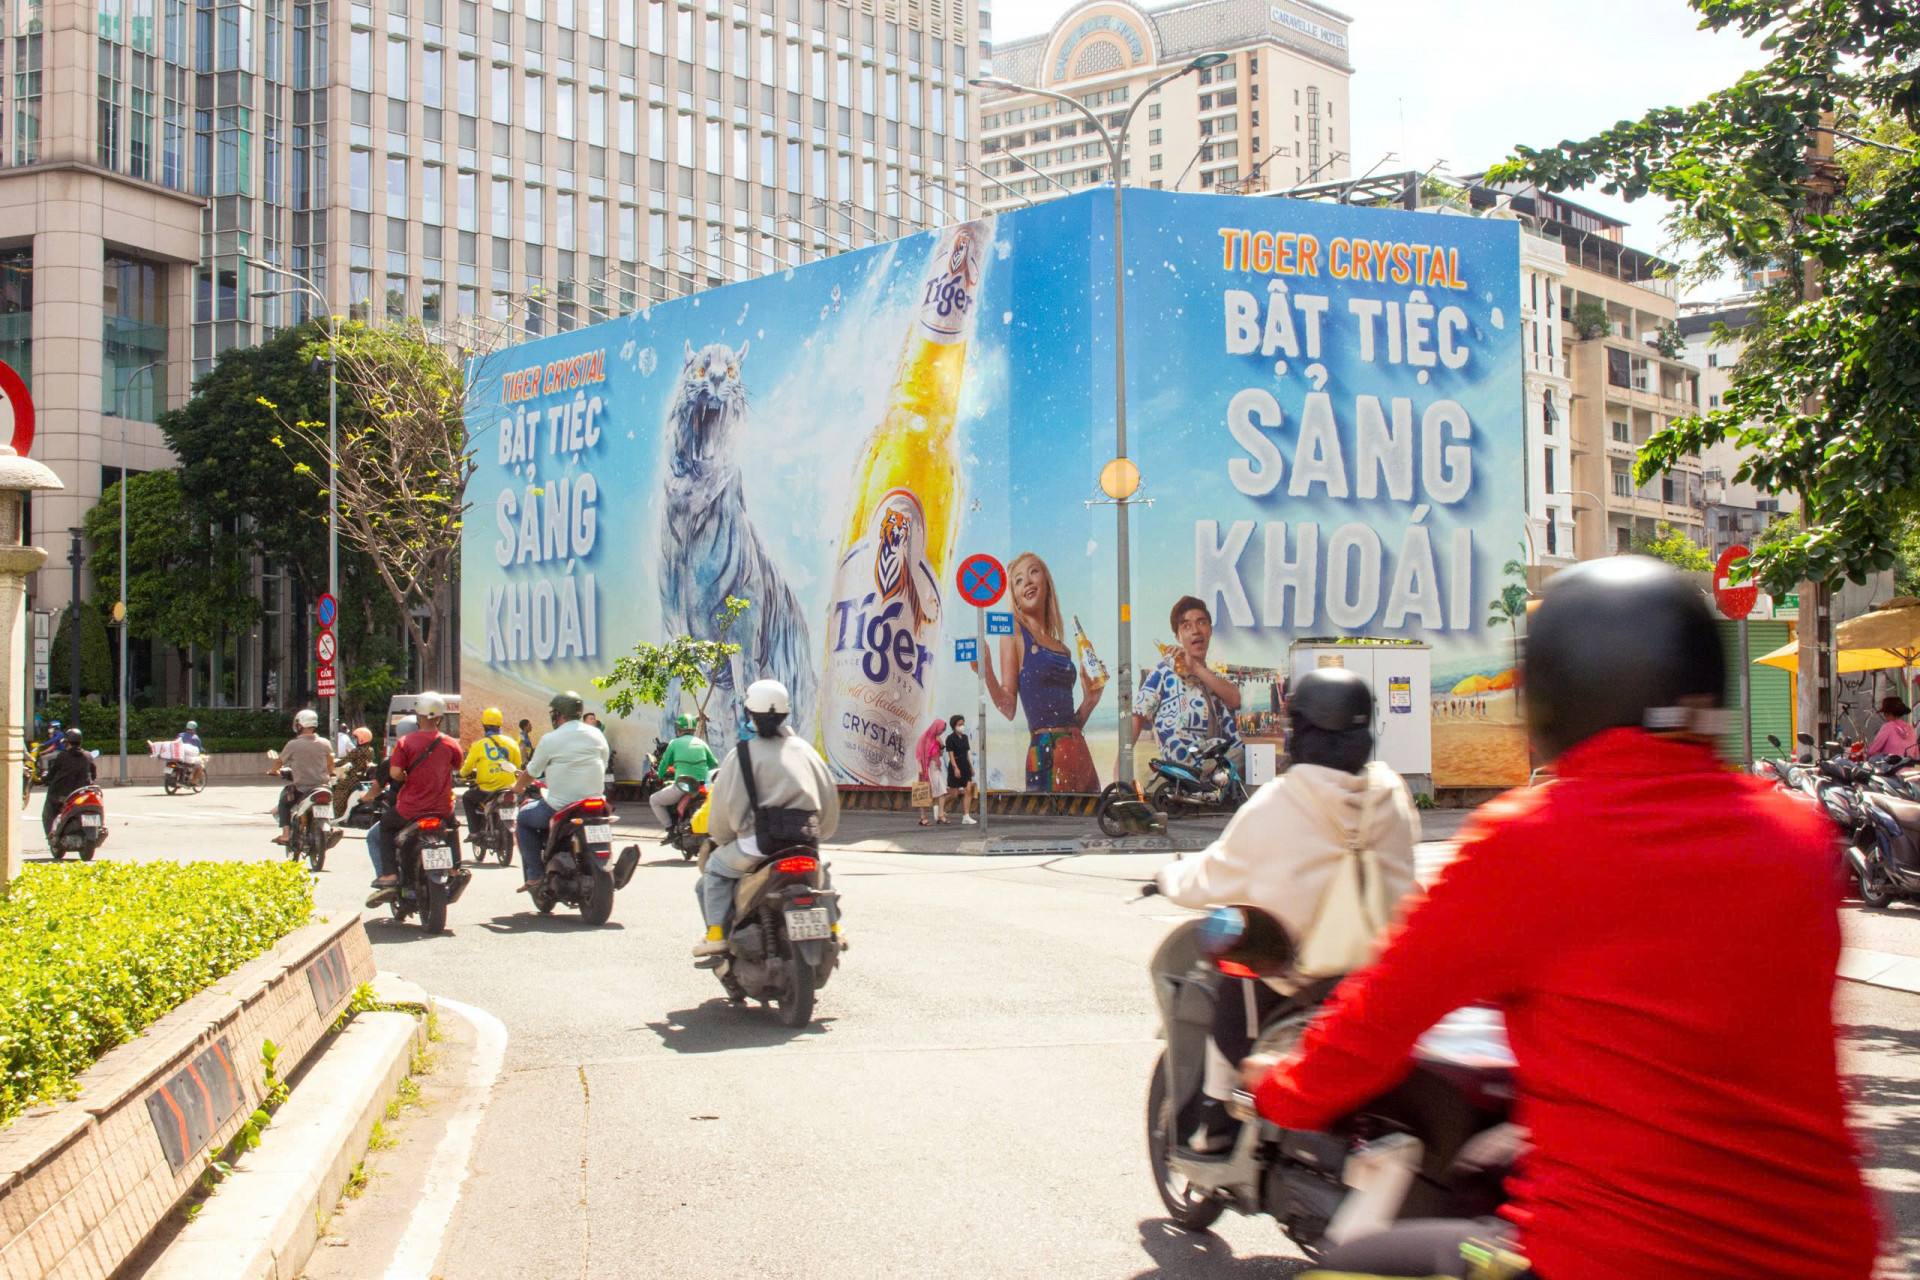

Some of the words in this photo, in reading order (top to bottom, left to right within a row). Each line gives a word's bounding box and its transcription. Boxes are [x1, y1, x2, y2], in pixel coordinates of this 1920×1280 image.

[1272, 8, 1319, 37] CARAVELLE
[1321, 27, 1345, 48] HOTEL
[922, 272, 973, 317] Tiger
[1218, 228, 1320, 277] TIGER
[1328, 237, 1468, 290] CRYSTAL
[1224, 278, 1329, 376] BẬT
[1349, 290, 1469, 385] TIỆC
[501, 365, 542, 405] TIGER
[543, 348, 606, 395] CRYSTAL
[498, 404, 541, 476] BẬT
[548, 390, 602, 465] TIỆC
[1227, 363, 1472, 504] SẢNG
[496, 463, 597, 567] SẢNG
[484, 558, 597, 662] KHOÁI
[1195, 504, 1473, 630] KHOÁI
[834, 592, 934, 689] Tiger
[842, 712, 905, 756] CRYSTAL
[864, 690, 921, 729] Acclaimed
